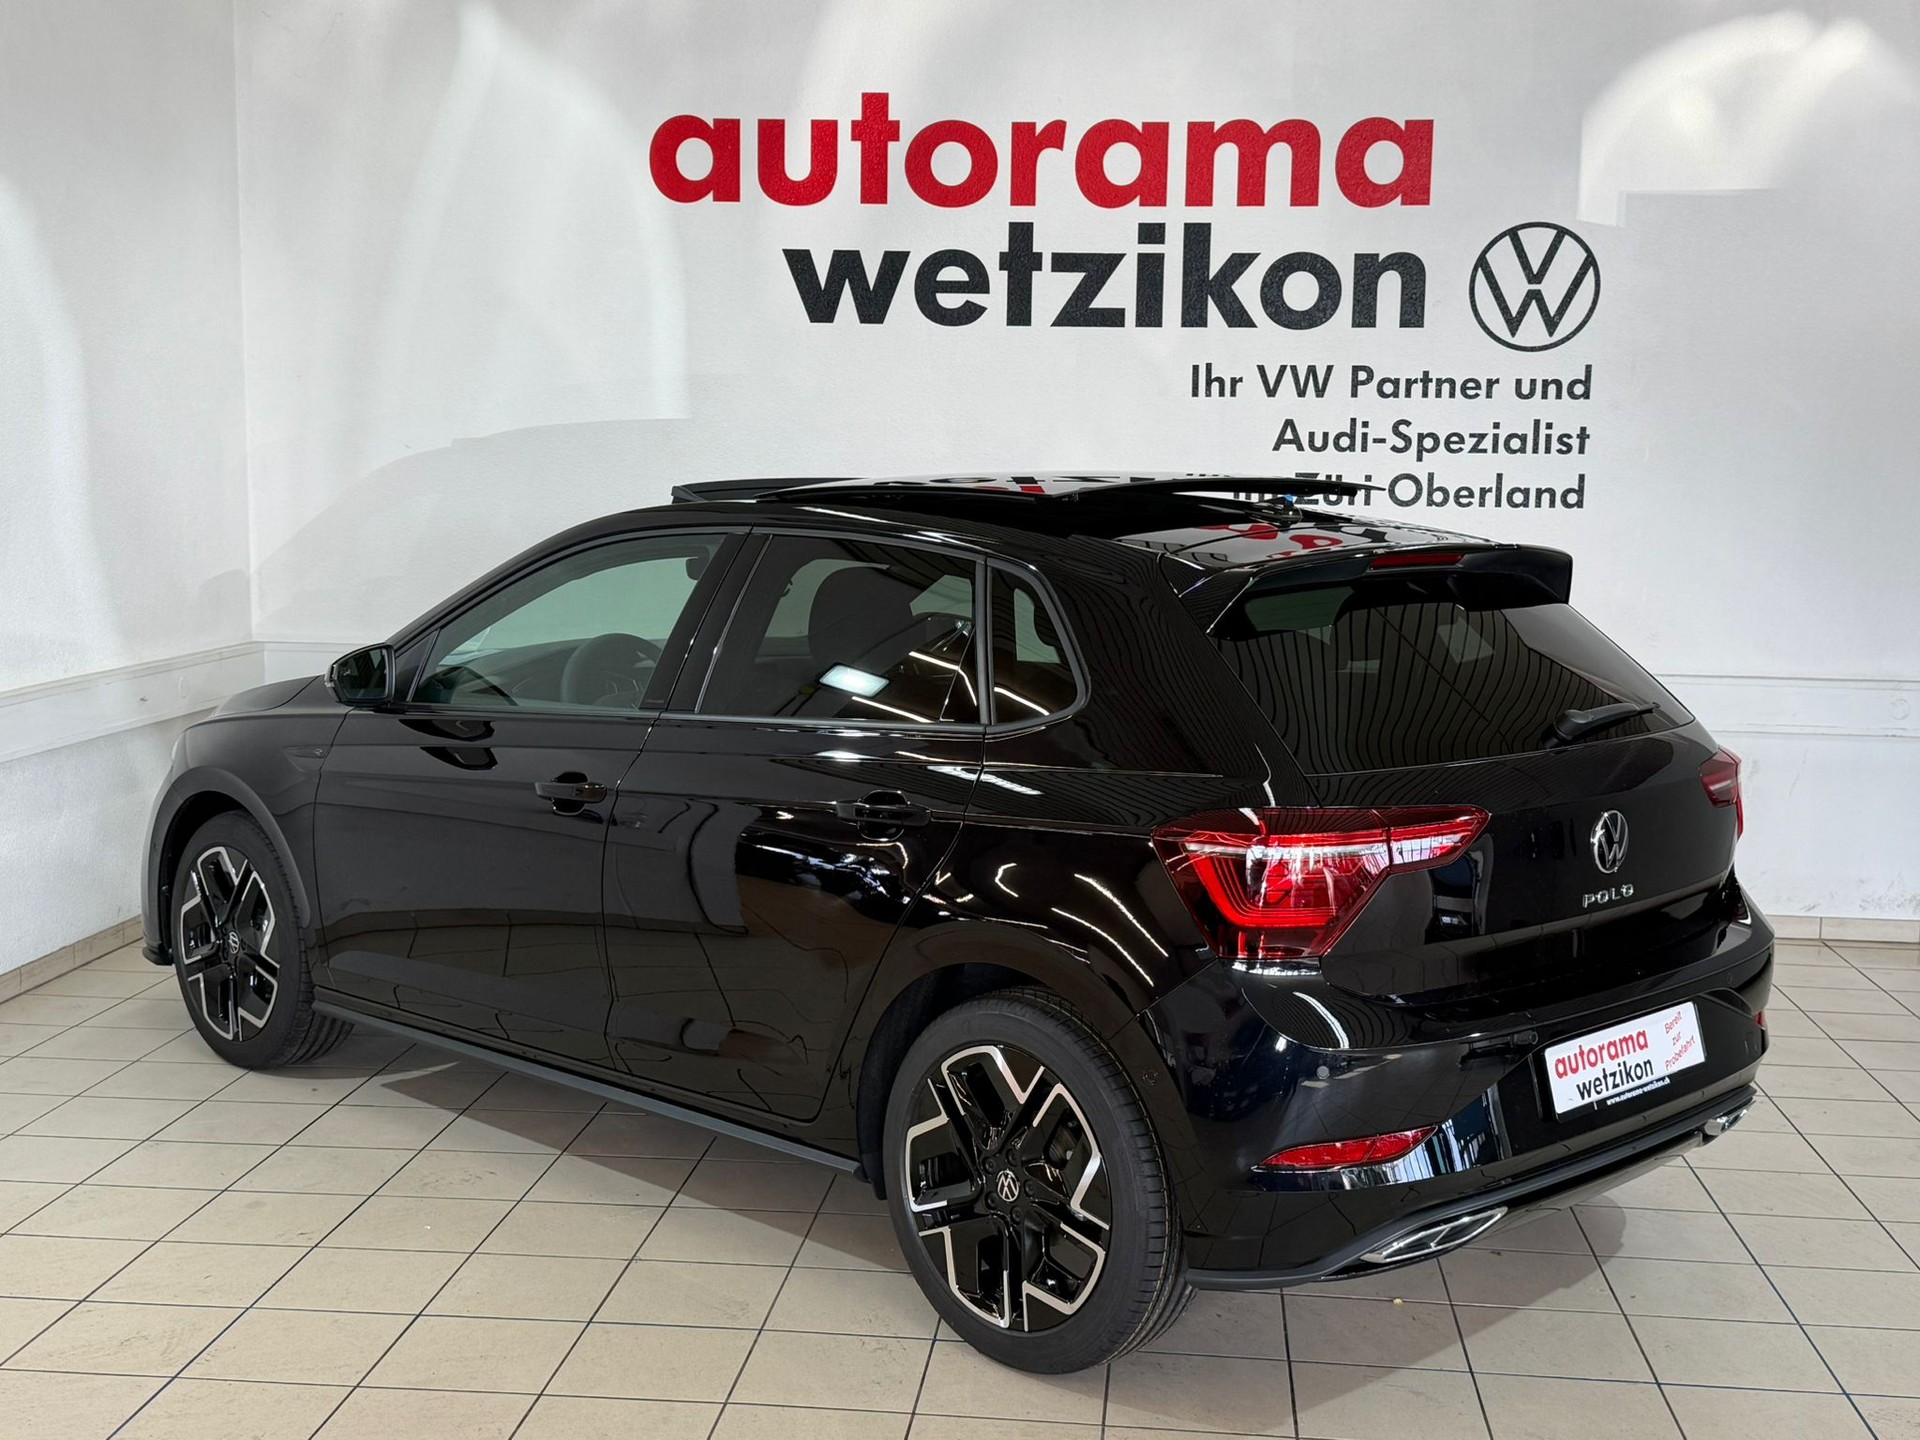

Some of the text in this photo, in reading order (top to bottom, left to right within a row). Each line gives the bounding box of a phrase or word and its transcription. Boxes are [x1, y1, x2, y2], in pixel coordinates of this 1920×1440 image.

[649, 92, 1434, 208] autorama
[782, 221, 1426, 330] wetzikon
[1191, 363, 1593, 401] Ihr VW Partner und
[1272, 417, 1591, 463] Audi-Spezialist
[1388, 472, 1586, 509] Oberland
[1582, 883, 1634, 908] POLO
[1555, 1029, 1649, 1079] autorama
[1576, 1058, 1654, 1101] wetzikon
